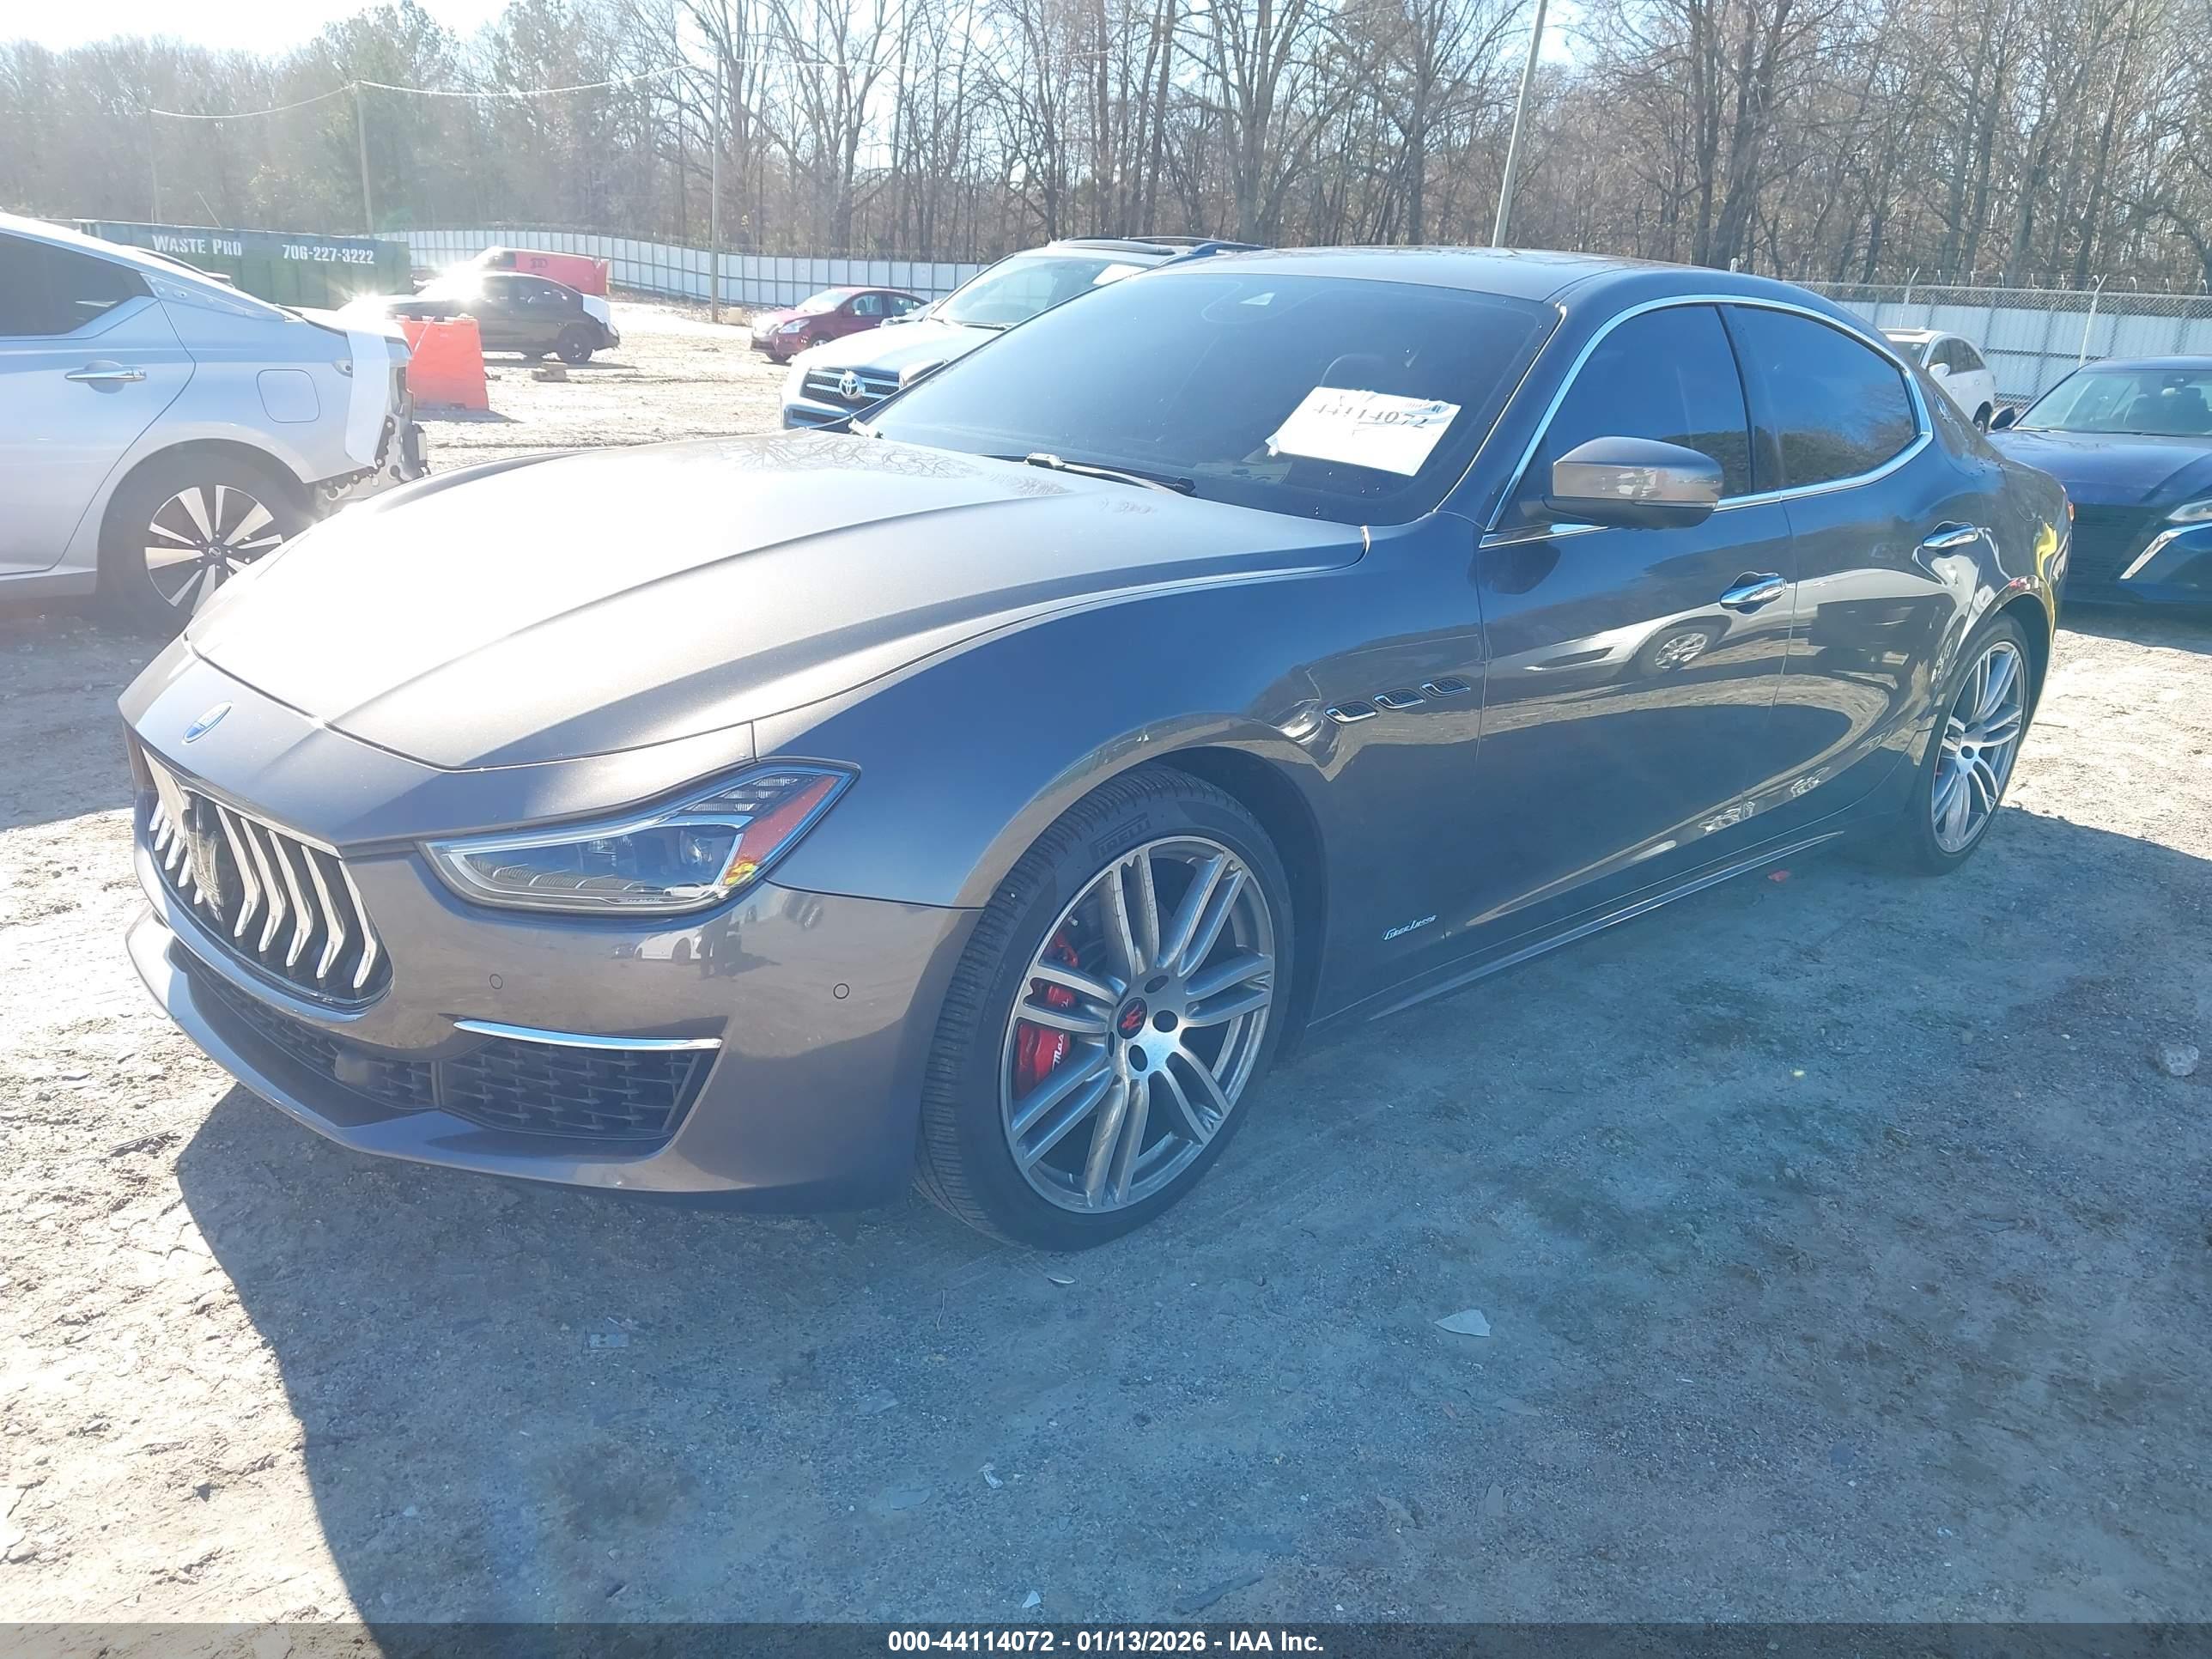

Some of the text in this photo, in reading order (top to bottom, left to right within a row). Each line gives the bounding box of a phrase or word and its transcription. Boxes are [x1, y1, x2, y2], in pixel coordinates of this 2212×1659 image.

[152, 235, 242, 256] WASTE PRO
[282, 244, 374, 264] 706-227-3222
